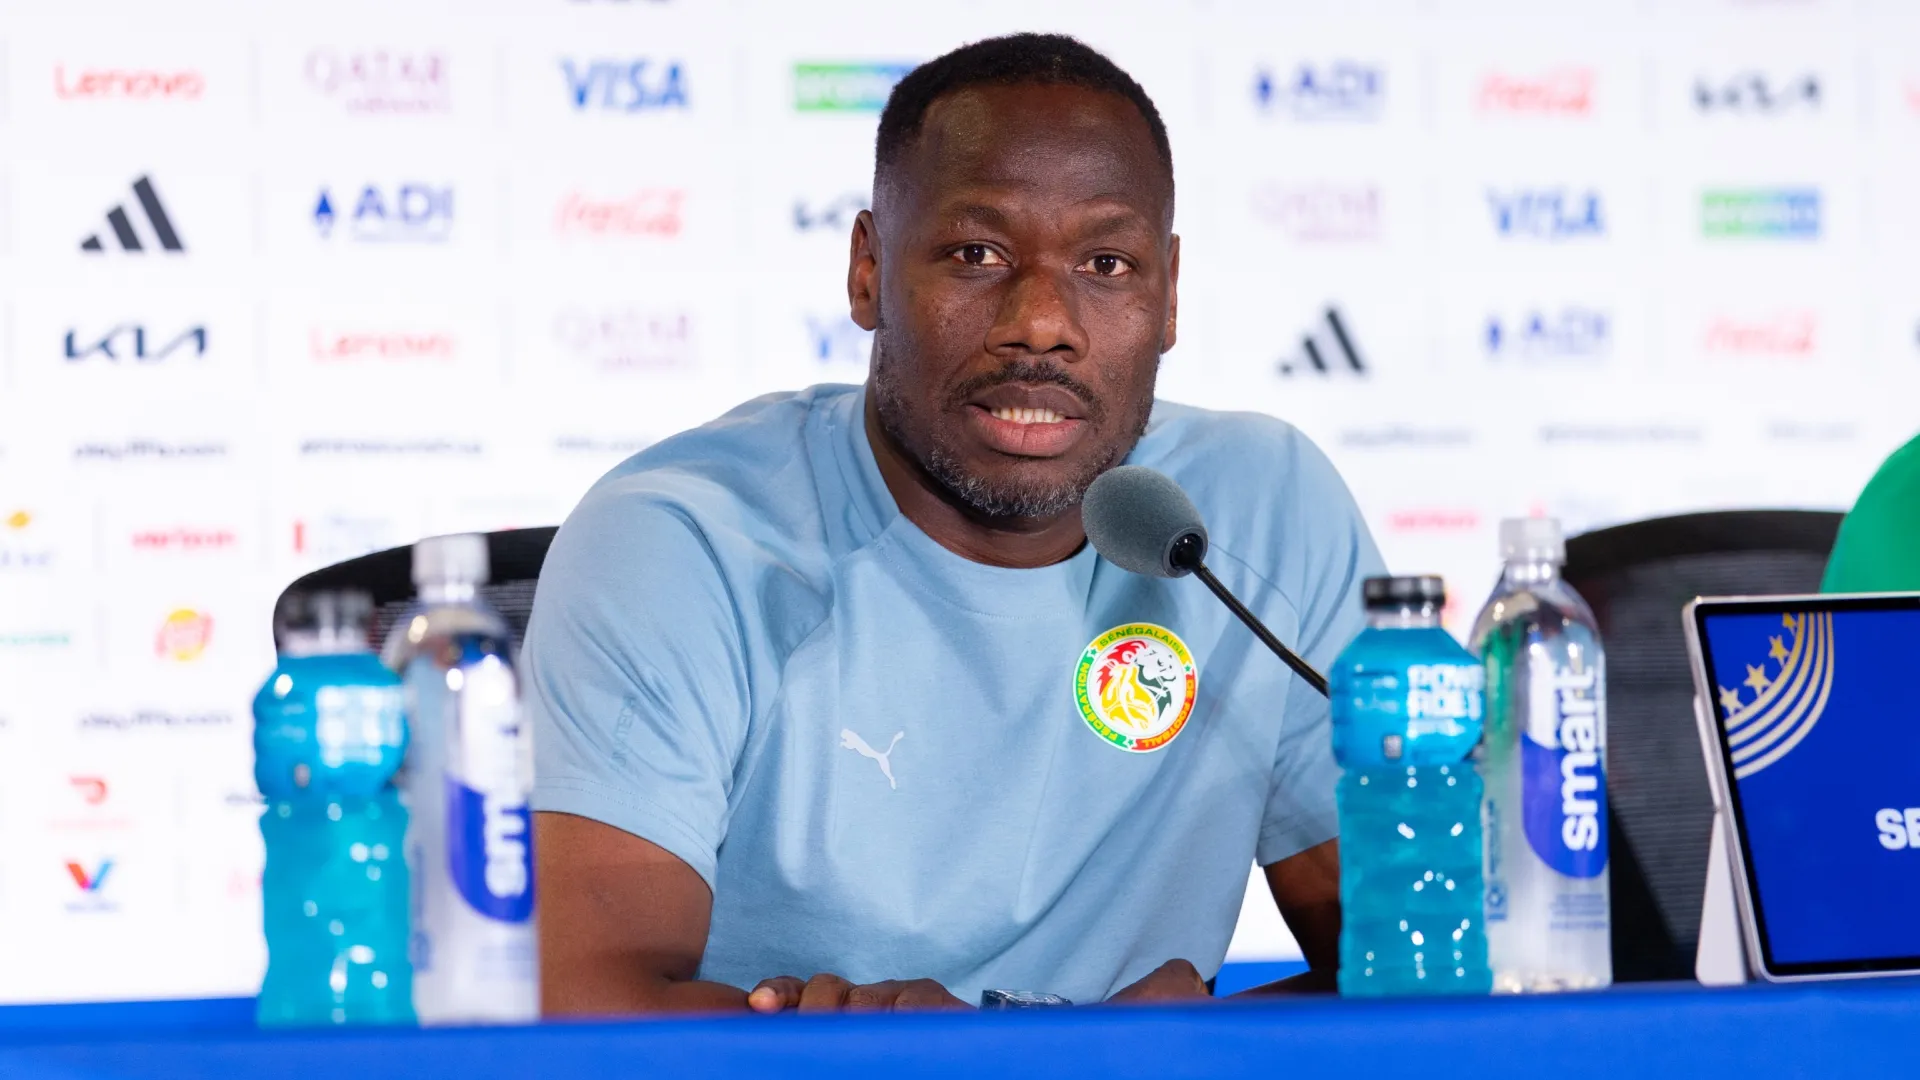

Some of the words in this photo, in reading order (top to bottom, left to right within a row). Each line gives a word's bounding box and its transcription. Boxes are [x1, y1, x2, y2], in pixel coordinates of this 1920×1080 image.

[54, 65, 205, 101] Lenovo
[562, 58, 690, 113] VISA
[353, 183, 454, 222] ADI
[1488, 189, 1606, 239] VISA
[64, 324, 208, 361] KIA
[1077, 662, 1118, 741] FÉDÉRATION
[1141, 701, 1191, 748] FOOTBALL
[1554, 664, 1600, 851] smart
